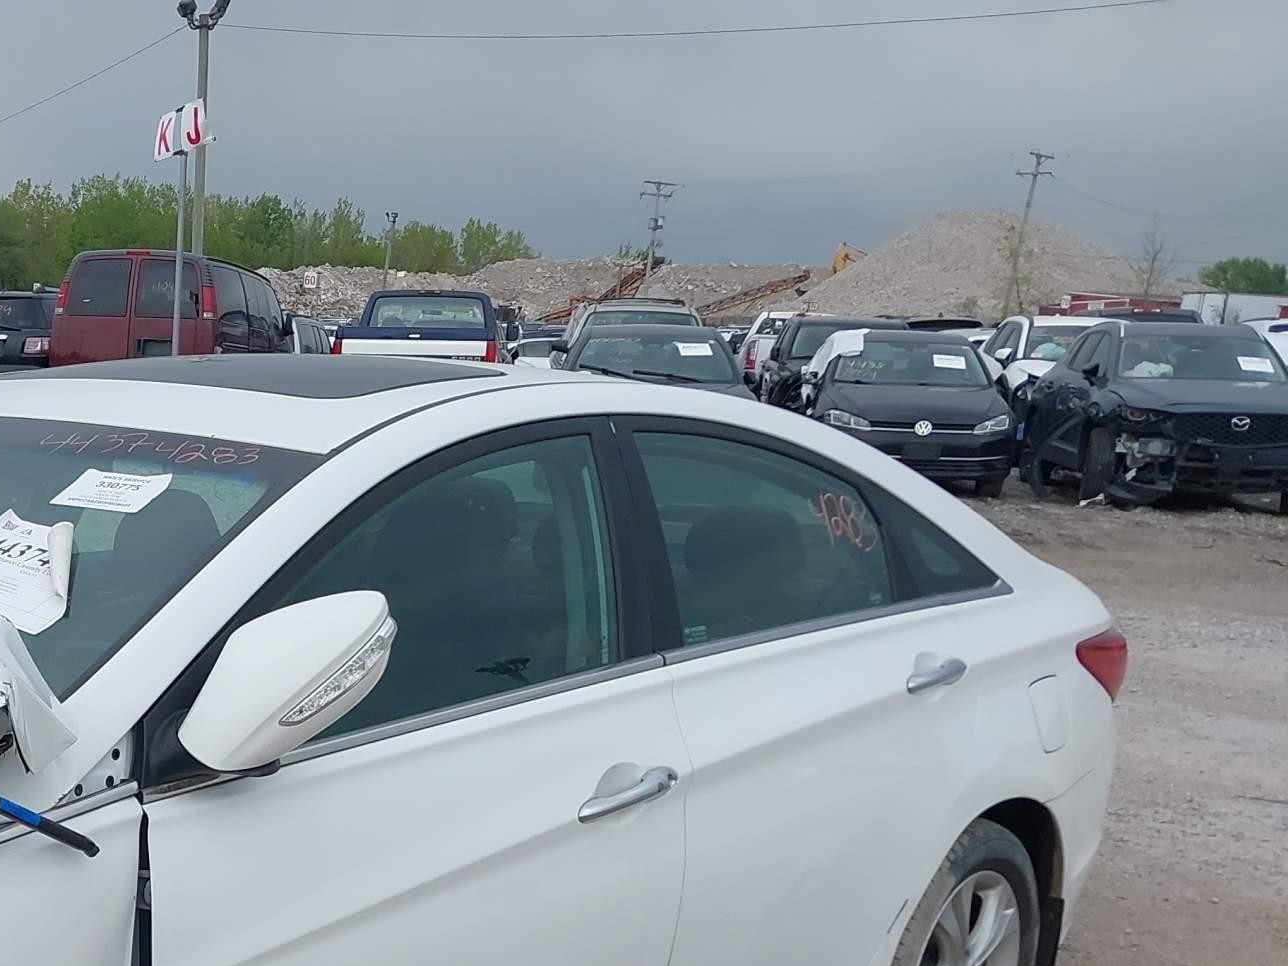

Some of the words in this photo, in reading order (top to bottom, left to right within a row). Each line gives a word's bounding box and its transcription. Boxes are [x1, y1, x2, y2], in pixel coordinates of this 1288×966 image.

[158, 117, 173, 156] K
[186, 106, 201, 145] J
[304, 274, 316, 286] 60
[39, 432, 261, 465] 44374283
[95, 480, 143, 492] 330775
